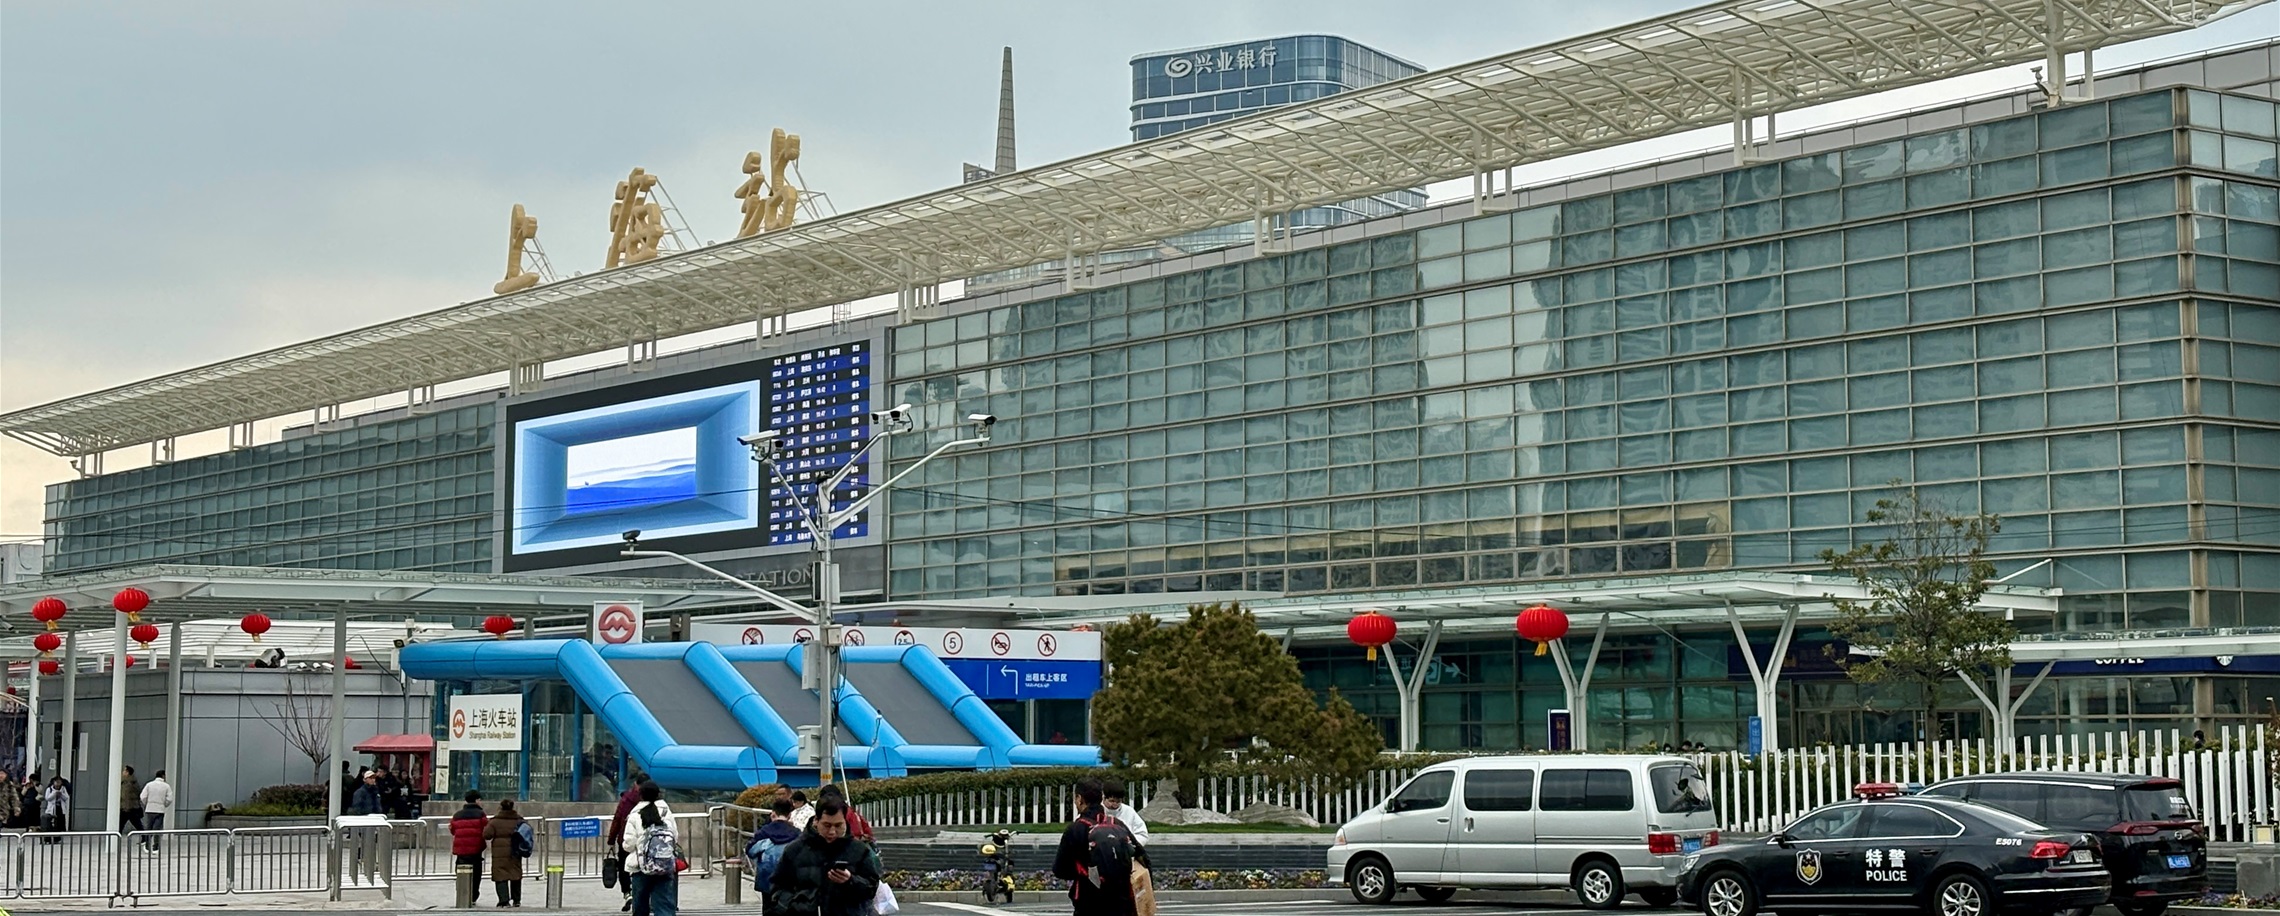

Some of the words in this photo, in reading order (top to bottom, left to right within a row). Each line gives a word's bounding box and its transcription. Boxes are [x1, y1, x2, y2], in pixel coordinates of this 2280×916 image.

[1194, 46, 1277, 74] 兴业银行
[494, 128, 800, 294] 上海站
[949, 637, 957, 649] 5
[469, 708, 517, 729] 上海火车站
[469, 731, 486, 740] Shanghai
[487, 731, 502, 740] Railway
[503, 731, 516, 739] Station
[1865, 848, 1907, 868] 特警
[1866, 870, 1908, 882] POLICE
